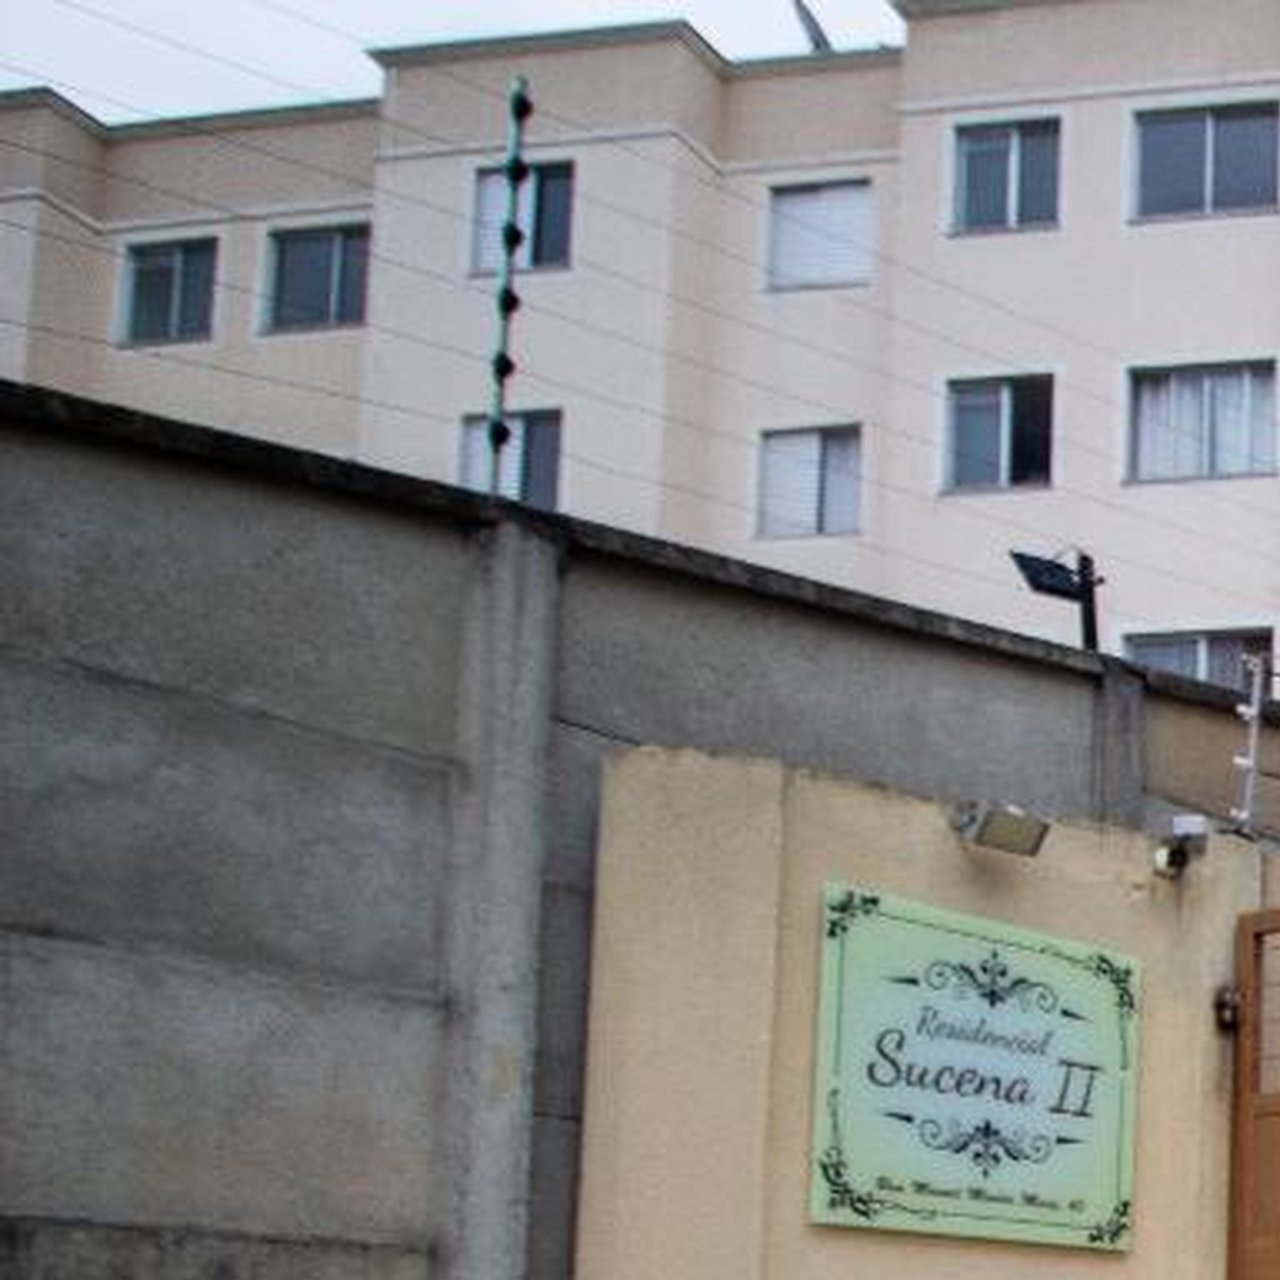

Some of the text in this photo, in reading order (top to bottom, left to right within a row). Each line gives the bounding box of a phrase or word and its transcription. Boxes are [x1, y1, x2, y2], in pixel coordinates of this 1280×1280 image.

[915, 1006, 1056, 1057] Residencial
[867, 1029, 1105, 1118] Sucena II
